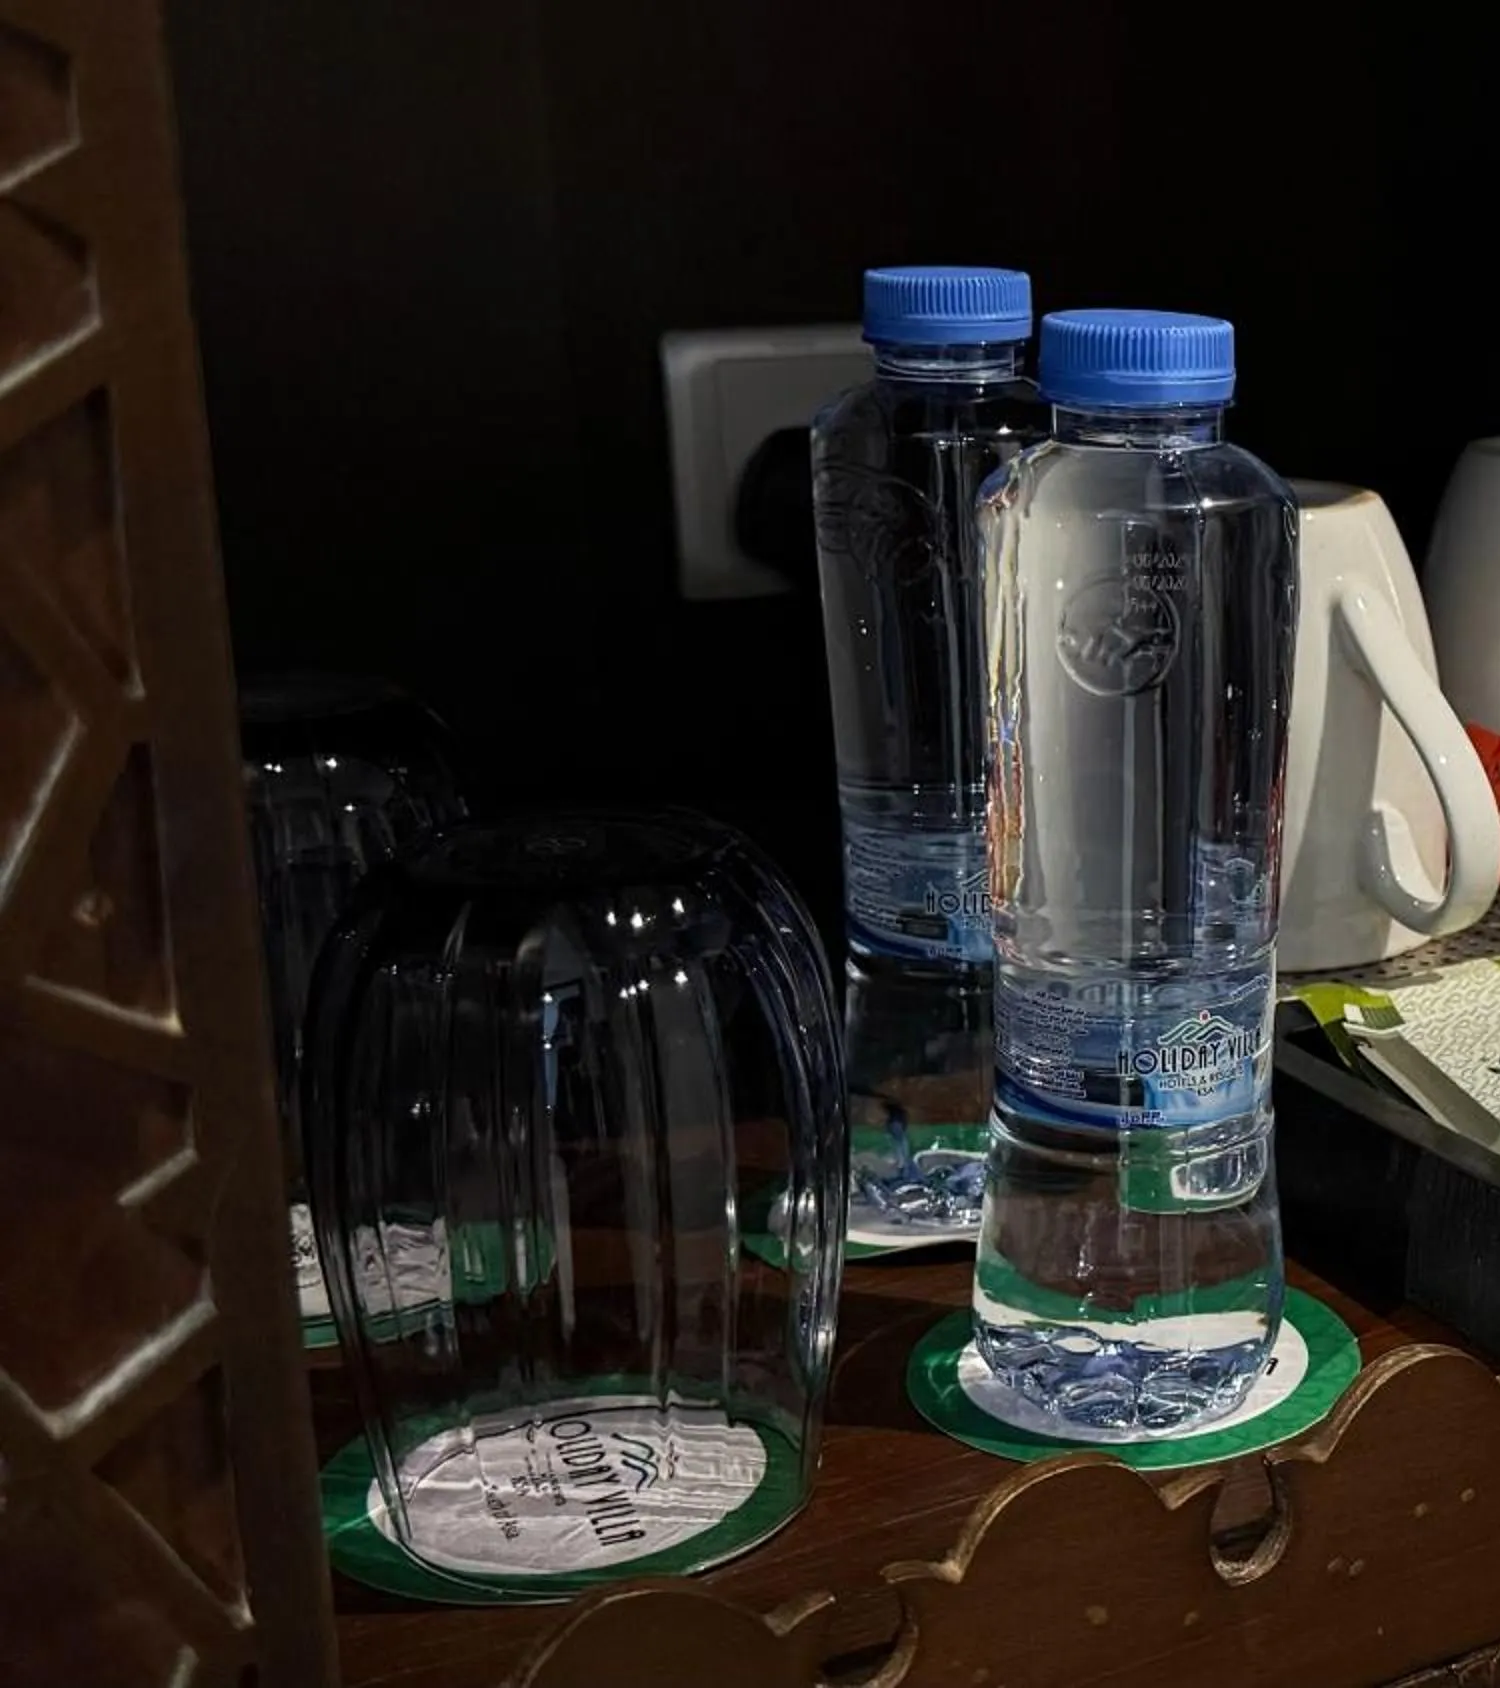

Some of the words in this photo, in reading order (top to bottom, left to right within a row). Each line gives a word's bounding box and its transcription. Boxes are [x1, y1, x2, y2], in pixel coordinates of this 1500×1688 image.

[925, 892, 993, 914] HOLID
[1117, 1042, 1222, 1075] HOLIDAY
[582, 1489, 647, 1546] VILLA
